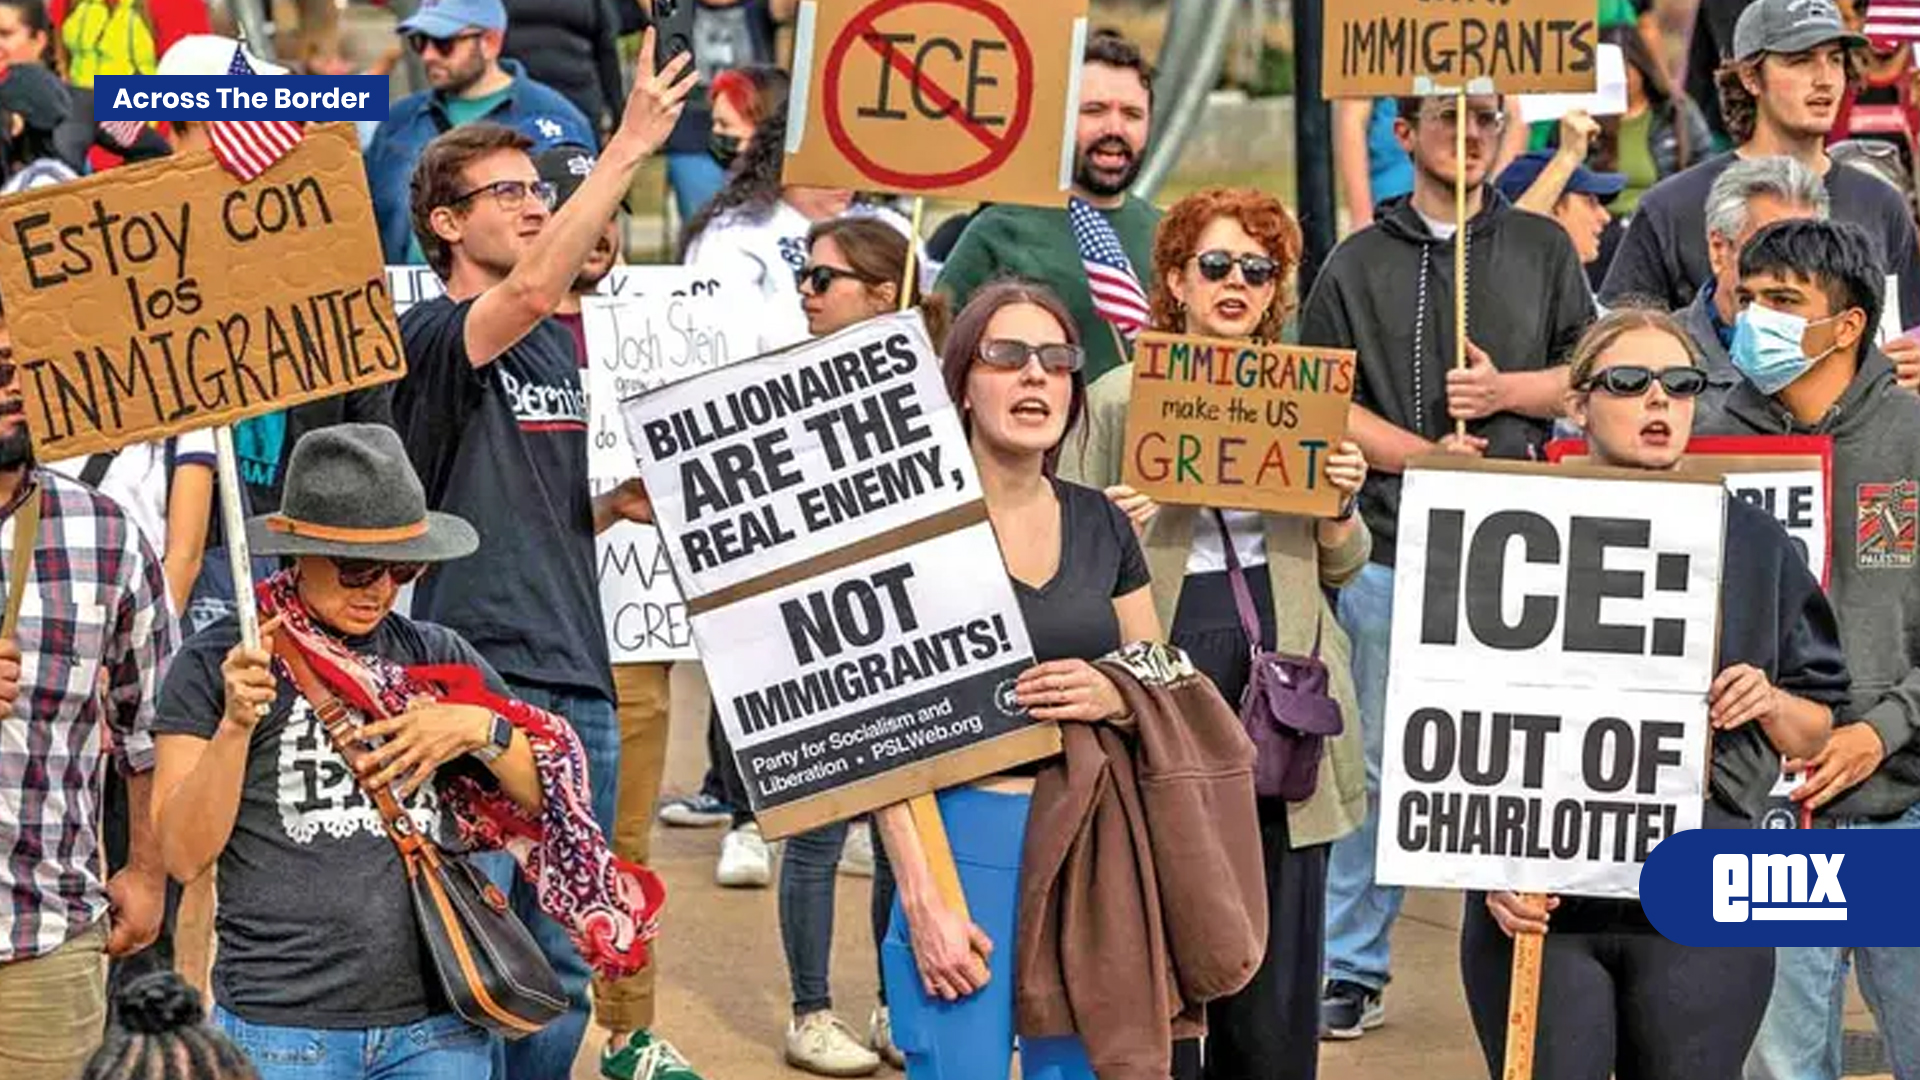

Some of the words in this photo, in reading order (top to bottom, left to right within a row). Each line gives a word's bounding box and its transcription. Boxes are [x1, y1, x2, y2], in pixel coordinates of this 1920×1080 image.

[857, 33, 1007, 127] ICE
[1341, 18, 1594, 77] IMMIGRANTS
[13, 200, 190, 290] Estoy
[221, 176, 332, 243] con
[126, 276, 203, 331] los
[595, 303, 662, 373] Josh
[667, 300, 728, 368] Stein
[22, 279, 402, 446] INMIGRANTES
[642, 333, 918, 461] BILLIONAIRES
[1139, 343, 1352, 394] IMMIGRANTS
[678, 427, 804, 521] ARE
[806, 383, 932, 472] THE
[1161, 396, 1220, 421] make
[1227, 397, 1257, 424] the
[1265, 401, 1298, 429] US
[1135, 432, 1330, 490] GREAT
[679, 505, 796, 574] REAL
[797, 445, 966, 535] ENEMY,
[779, 562, 918, 666] NOT
[1420, 507, 1690, 657] ICE:
[614, 602, 693, 652] GRE
[732, 614, 1012, 736] IMMIGRANTS!
[752, 748, 799, 774] Party
[801, 741, 827, 760] for
[828, 713, 915, 750] Socialism
[917, 697, 953, 723] and
[758, 756, 848, 796] Liberation
[870, 714, 984, 760] PSLWeb.org
[1402, 706, 1561, 790] OUT
[1582, 716, 1685, 795] OF
[1397, 790, 1677, 863] CHARLOTTE!
